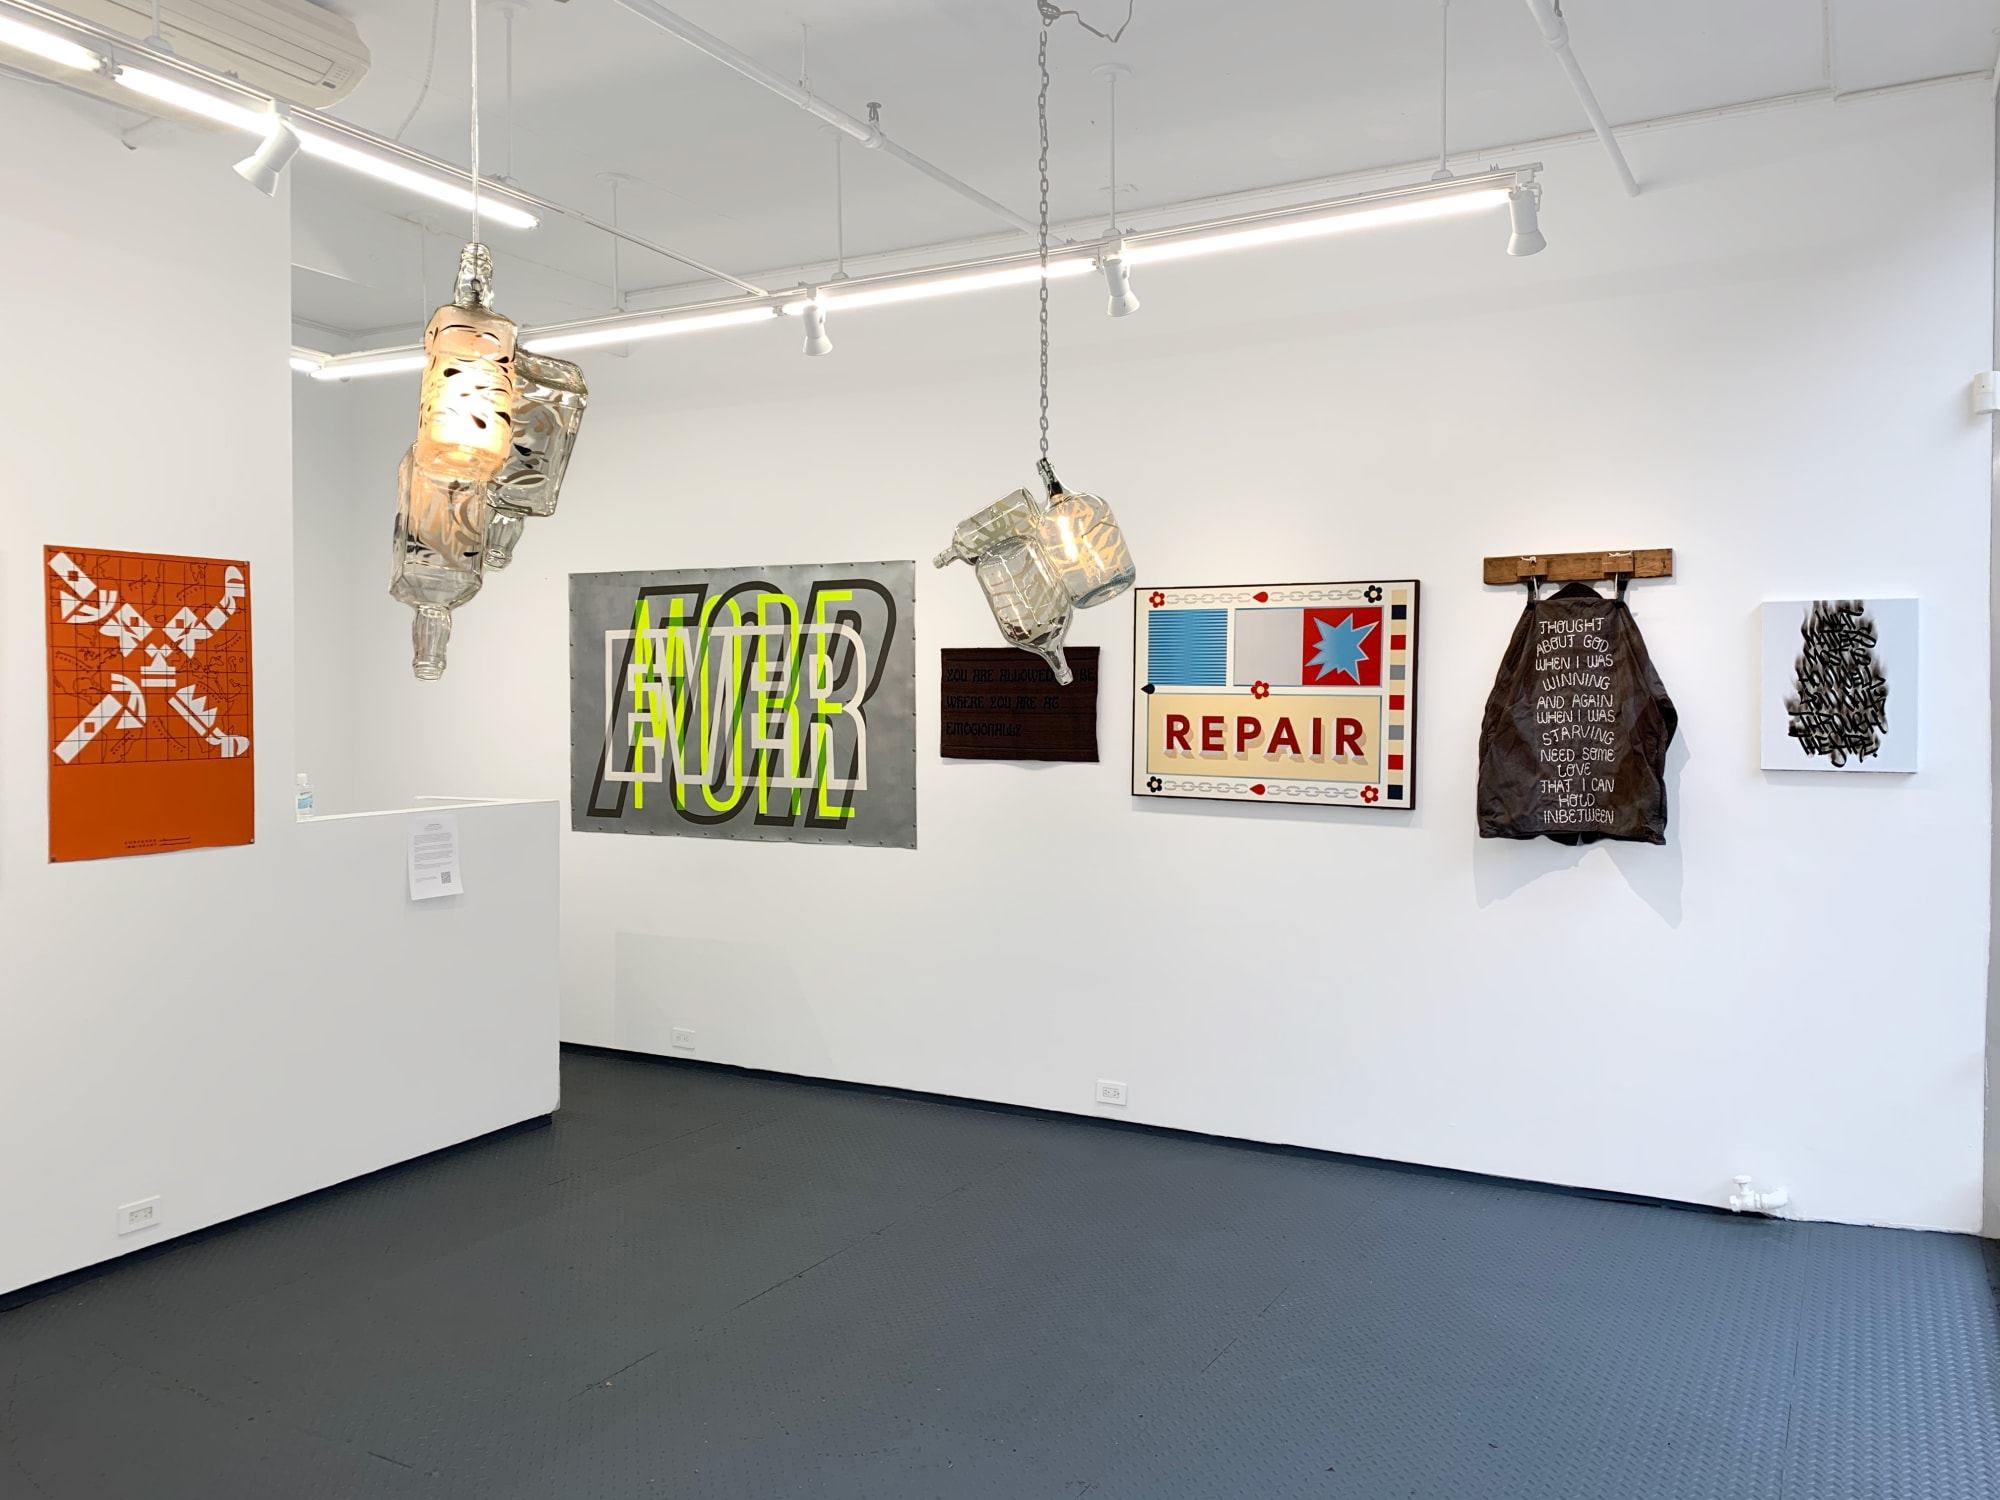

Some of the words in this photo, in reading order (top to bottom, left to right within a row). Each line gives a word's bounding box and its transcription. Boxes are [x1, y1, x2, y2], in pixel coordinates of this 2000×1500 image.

[1539, 618, 1604, 634] THOUGHT
[1537, 633, 1575, 656] ABOUT
[1584, 635, 1608, 652] GOD
[1536, 655, 1570, 671] WHEN
[1576, 656, 1581, 668] I
[1587, 654, 1613, 668] WAS
[946, 669, 967, 682] YOU
[972, 668, 994, 682] ARE
[999, 668, 1053, 682] ALLOWED
[1079, 667, 1095, 682] BE
[1543, 673, 1610, 691] WINNING
[946, 696, 984, 709] WHERE
[990, 696, 1012, 710] YOU
[1016, 695, 1037, 709] ARE
[1537, 696, 1564, 709] AND
[1572, 694, 1612, 707] AGAIN
[1537, 710, 1572, 723] WHEN
[1577, 709, 1582, 721] I
[1588, 709, 1615, 722] WAS
[1164, 714, 1367, 761] REPAIR
[1543, 725, 1614, 745] STARVING
[1541, 749, 1575, 762] NEED
[1583, 747, 1615, 761] SOME
[1557, 763, 1591, 777] LOVE
[1540, 779, 1572, 793] THAT
[1582, 778, 1587, 790] I
[1592, 778, 1614, 792] CAN
[1559, 794, 1594, 807] HOLD
[1544, 809, 1613, 823] INBETWEEN
